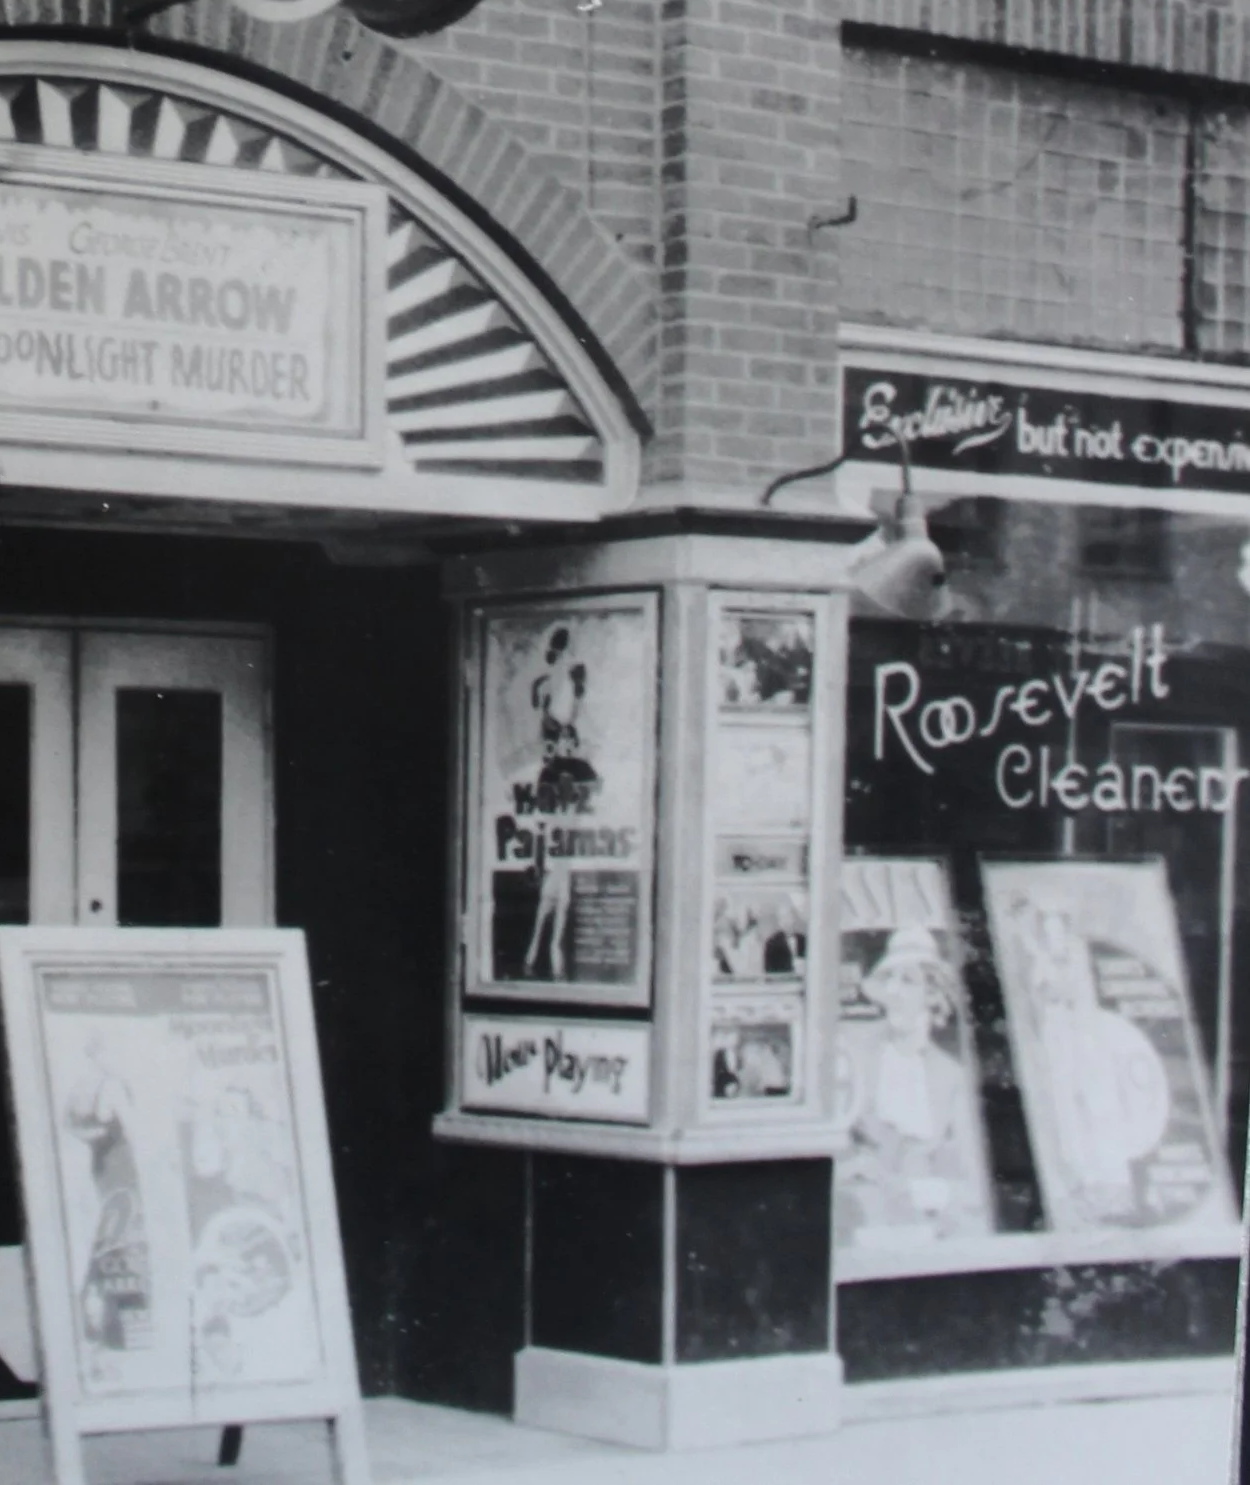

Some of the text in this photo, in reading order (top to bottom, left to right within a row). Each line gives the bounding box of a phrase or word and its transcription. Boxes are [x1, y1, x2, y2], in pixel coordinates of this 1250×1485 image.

[123, 268, 298, 334] ARROW
[170, 343, 311, 402] MURDER
[1017, 405, 1069, 457] but
[1074, 420, 1124, 460] not
[874, 623, 1169, 775] Roosevelt
